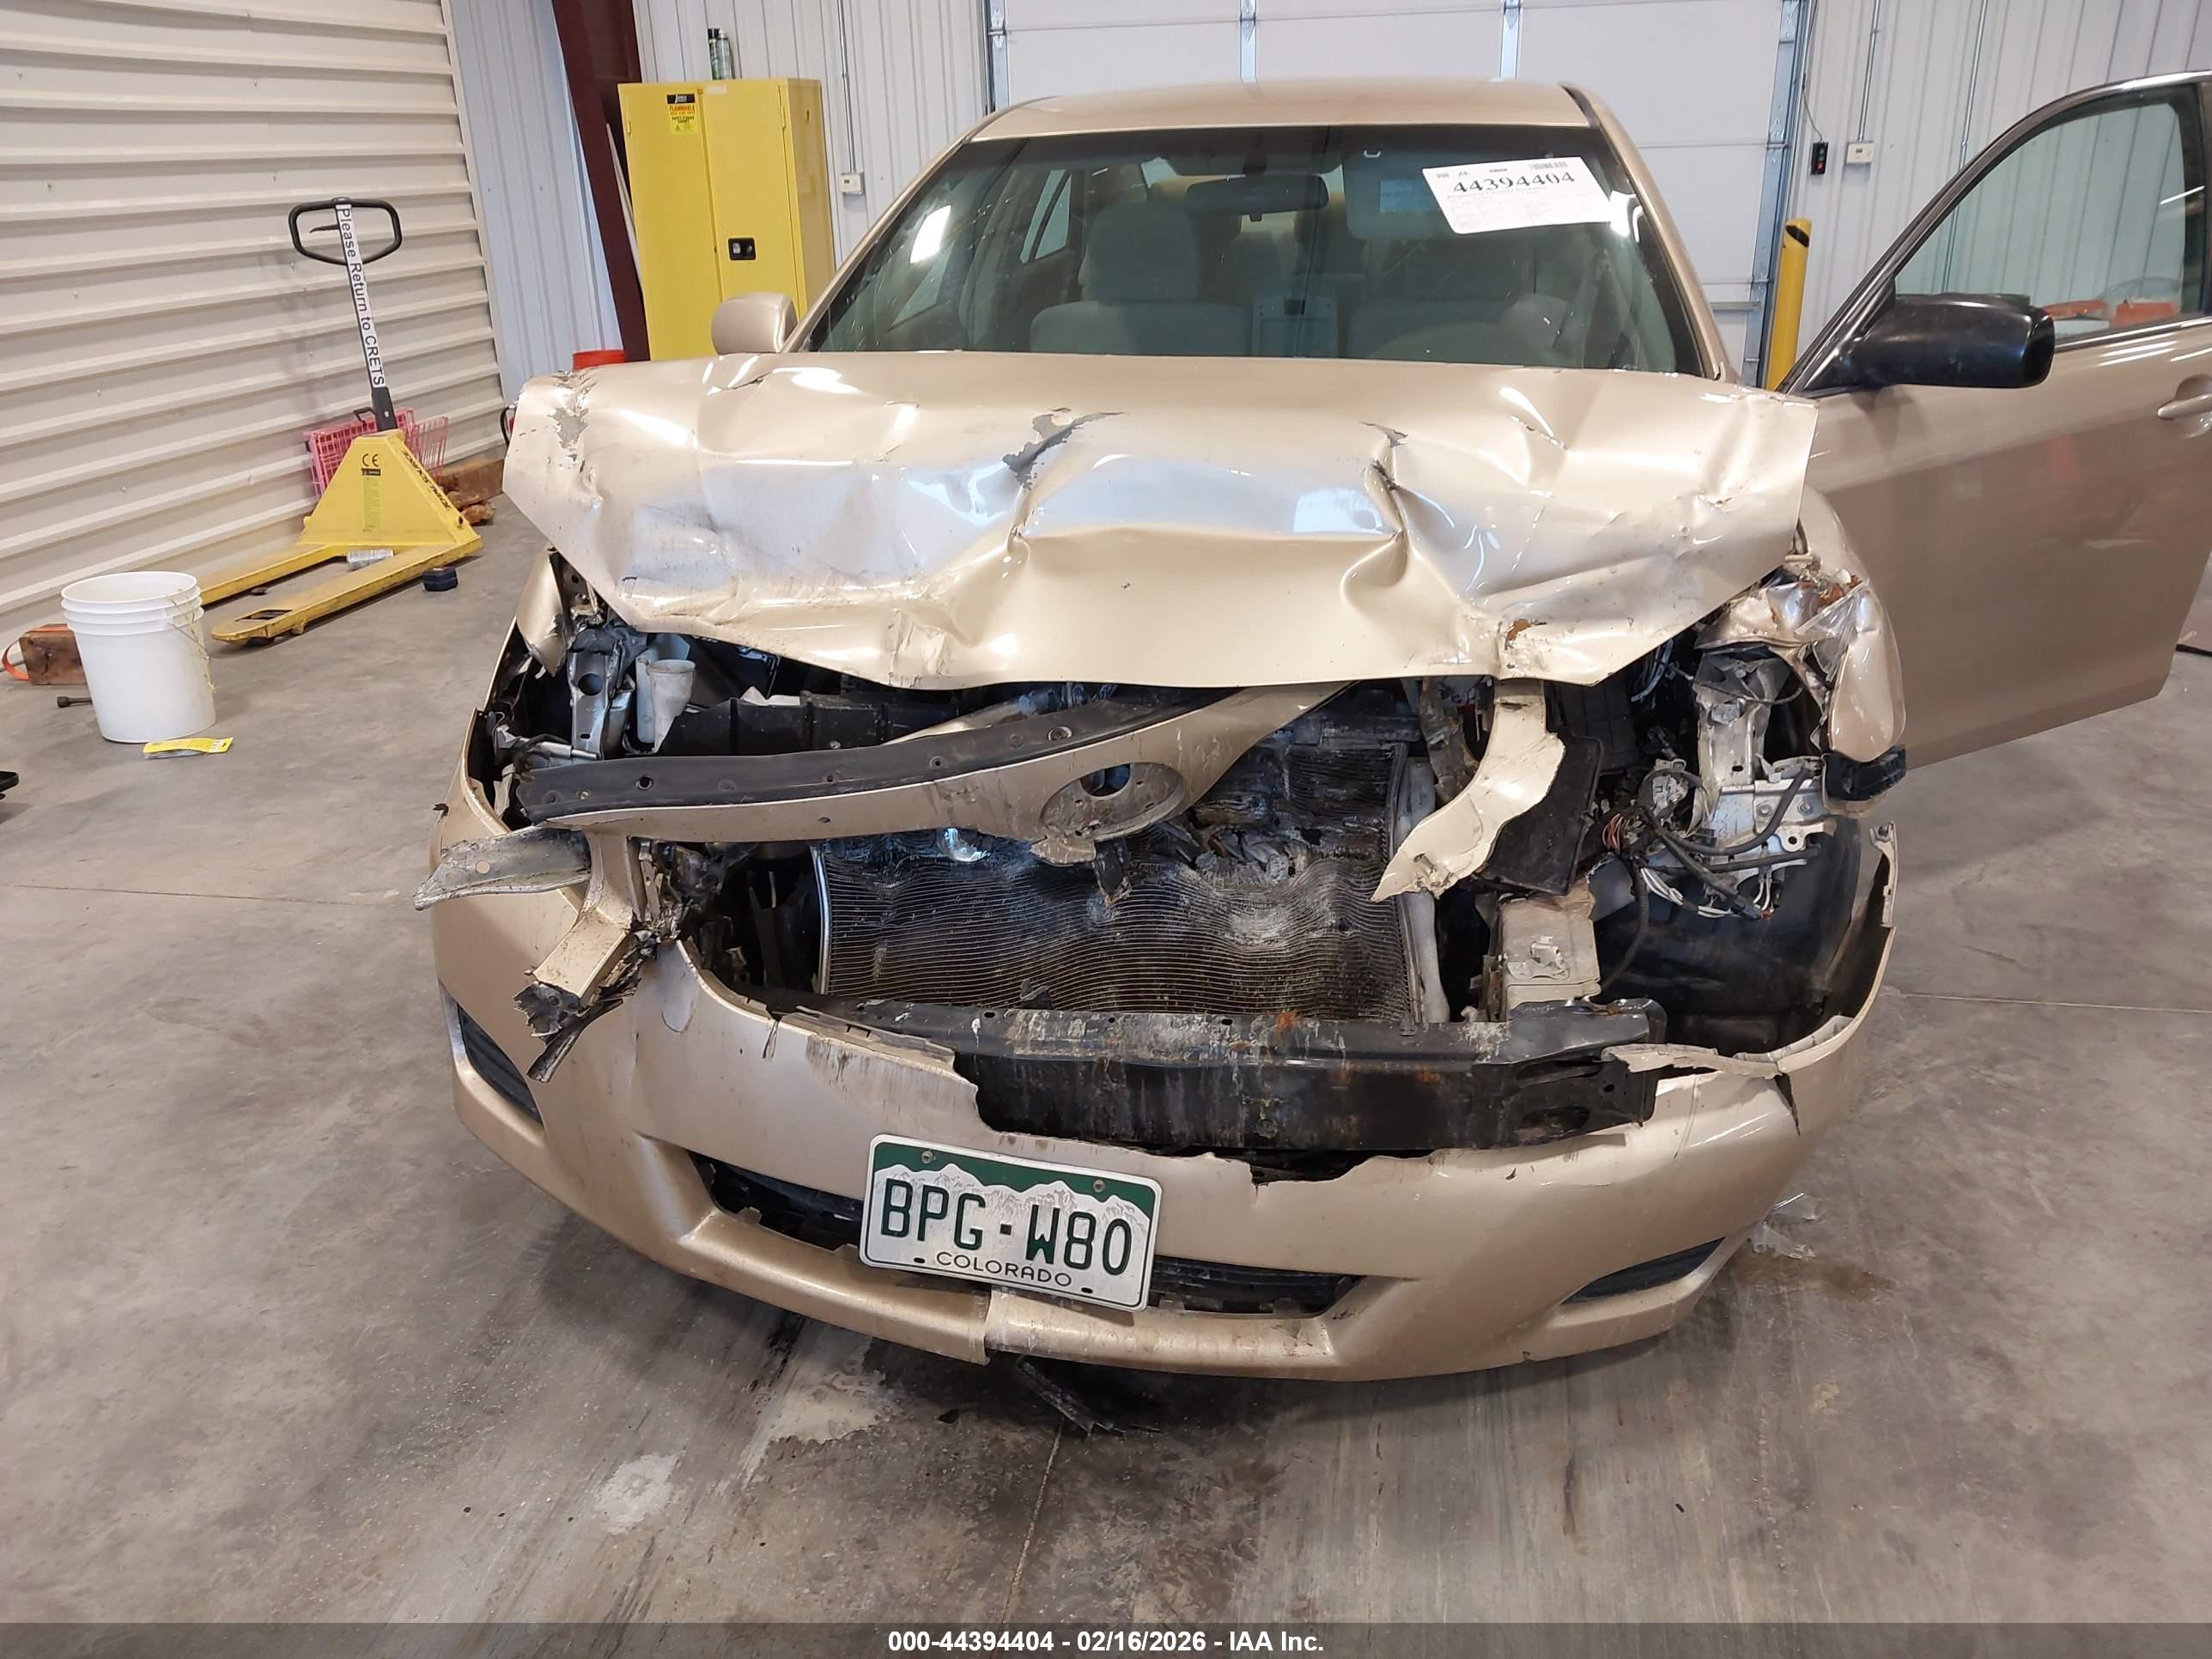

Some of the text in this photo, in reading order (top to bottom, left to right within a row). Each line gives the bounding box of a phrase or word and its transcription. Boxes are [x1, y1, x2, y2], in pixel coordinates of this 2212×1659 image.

[1453, 172, 1575, 192] 44394404
[341, 209, 385, 386] Please Return to CRETS
[936, 1251, 1073, 1287] COLORADO
